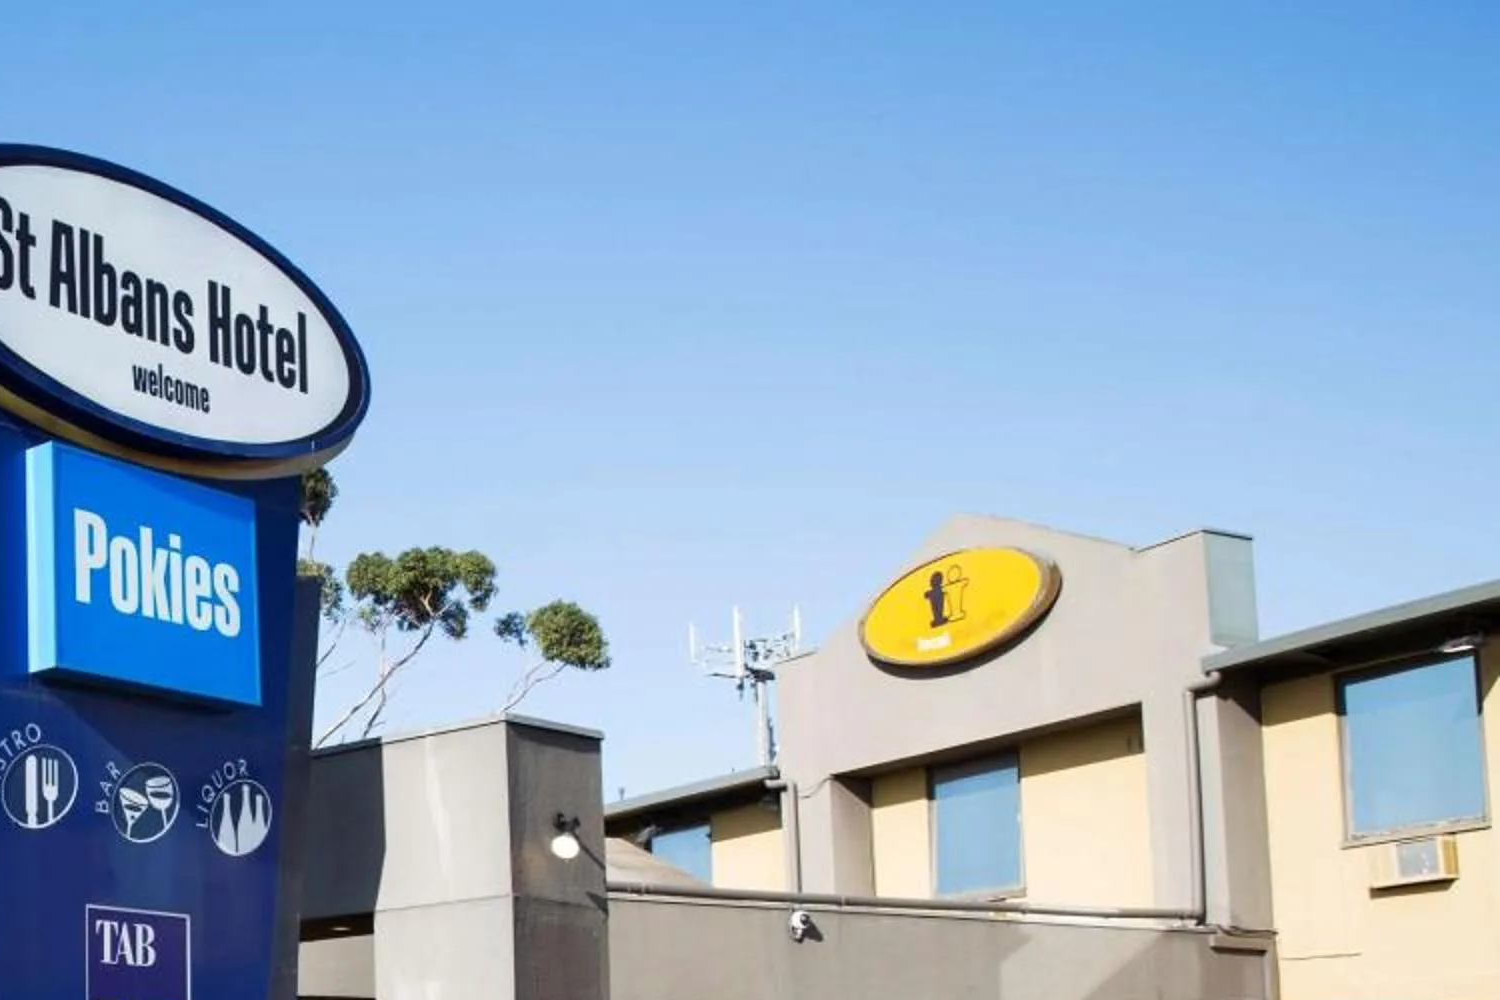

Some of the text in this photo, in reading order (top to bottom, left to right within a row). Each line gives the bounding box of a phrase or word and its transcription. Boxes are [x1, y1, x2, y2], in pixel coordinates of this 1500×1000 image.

[48, 218, 195, 355] Albans
[207, 279, 309, 395] Hotel
[131, 362, 211, 414] welcome
[73, 507, 242, 639] Pokies
[95, 760, 122, 814] BAR
[195, 758, 249, 828] LIQUOR
[95, 919, 157, 968] TAB
